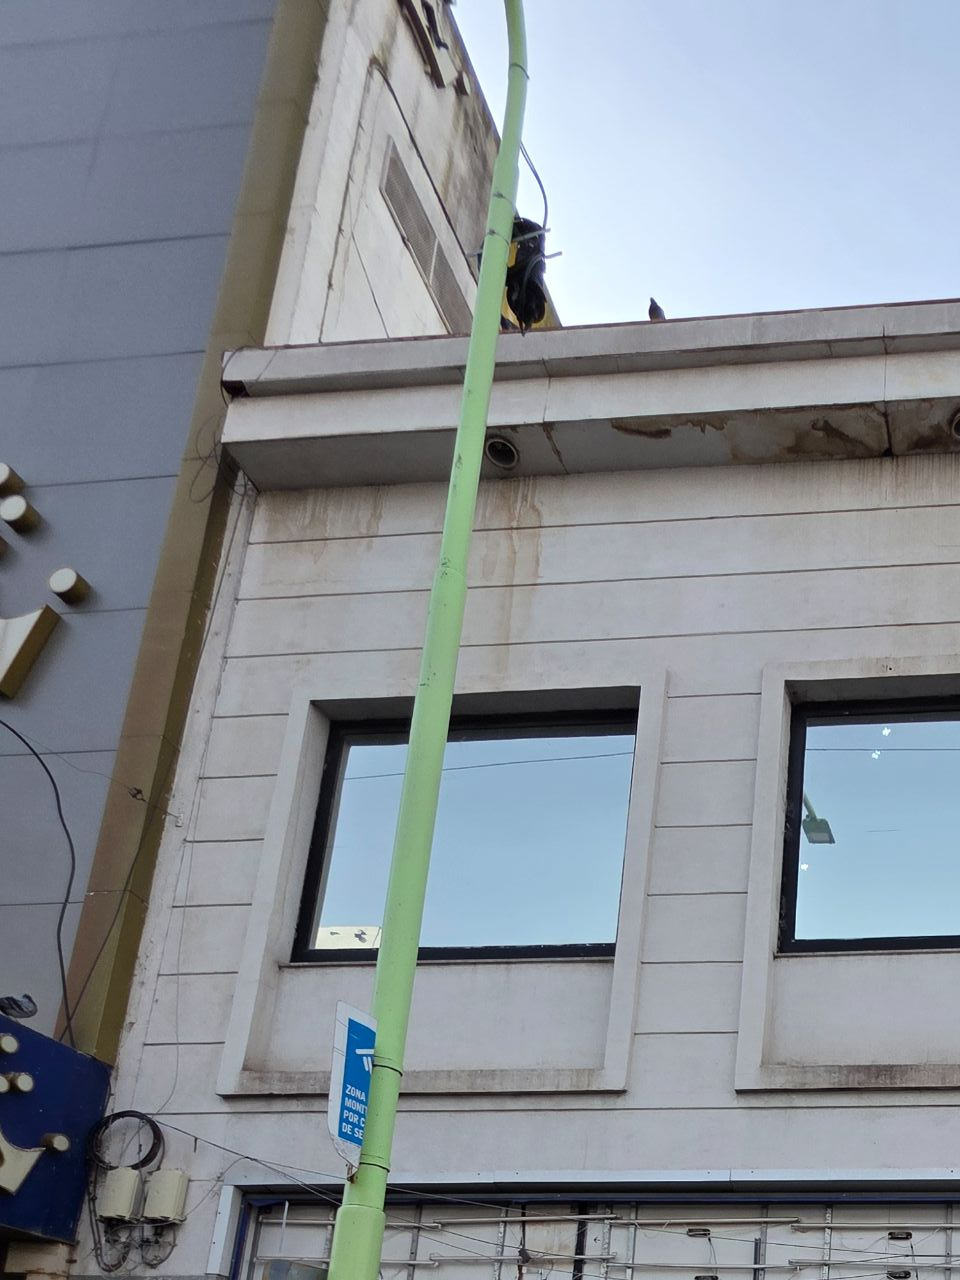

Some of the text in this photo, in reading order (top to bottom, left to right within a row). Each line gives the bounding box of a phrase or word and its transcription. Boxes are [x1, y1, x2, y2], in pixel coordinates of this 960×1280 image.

[345, 1084, 366, 1101] ZONA
[343, 1110, 359, 1124] POR
[341, 1123, 353, 1135] DE
